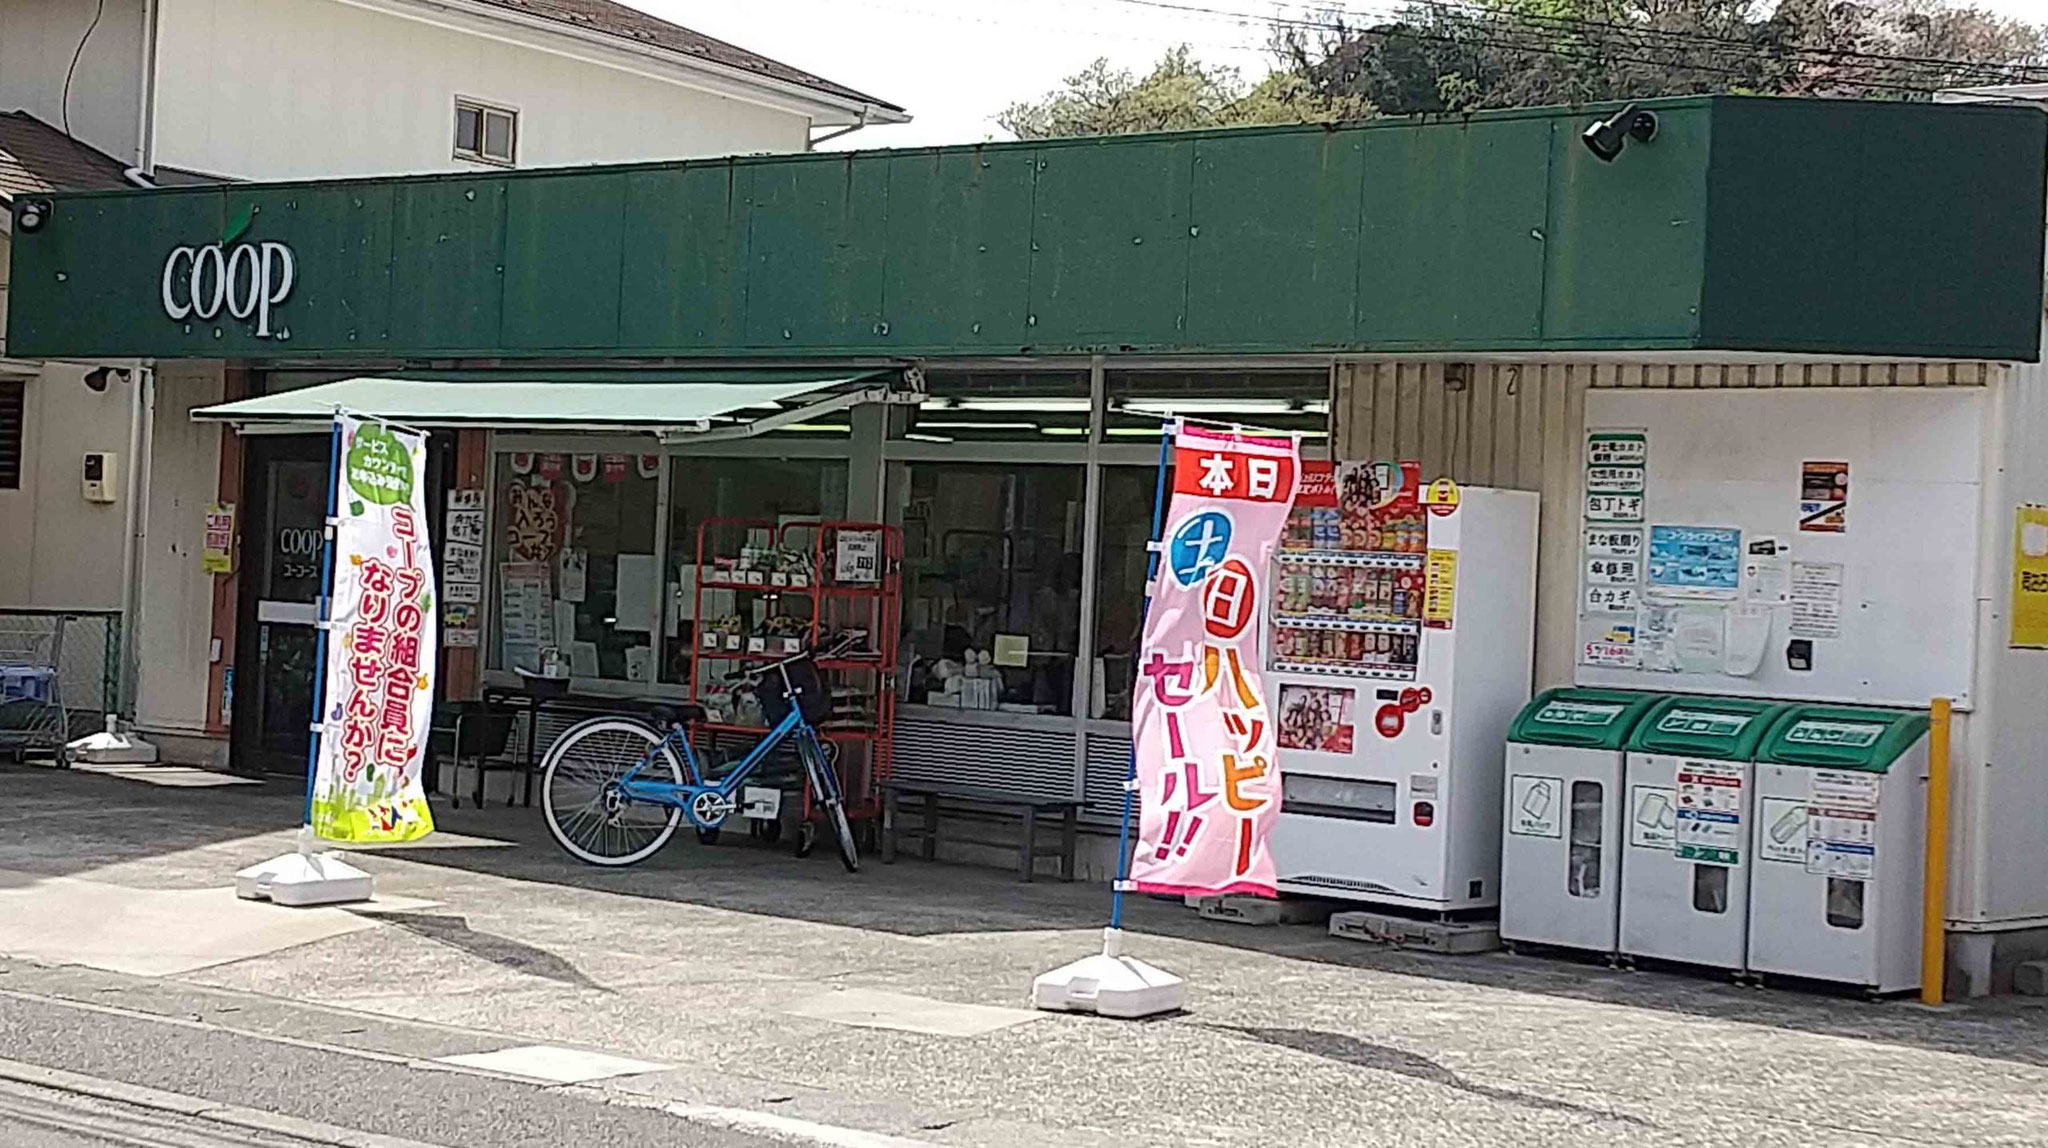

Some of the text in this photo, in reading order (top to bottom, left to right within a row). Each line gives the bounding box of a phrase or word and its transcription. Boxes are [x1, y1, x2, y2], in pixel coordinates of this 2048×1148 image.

[163, 242, 293, 337] COOP
[1199, 453, 1279, 499] 本日
[281, 529, 324, 561] COOP
[377, 510, 424, 763] コープの組合員に
